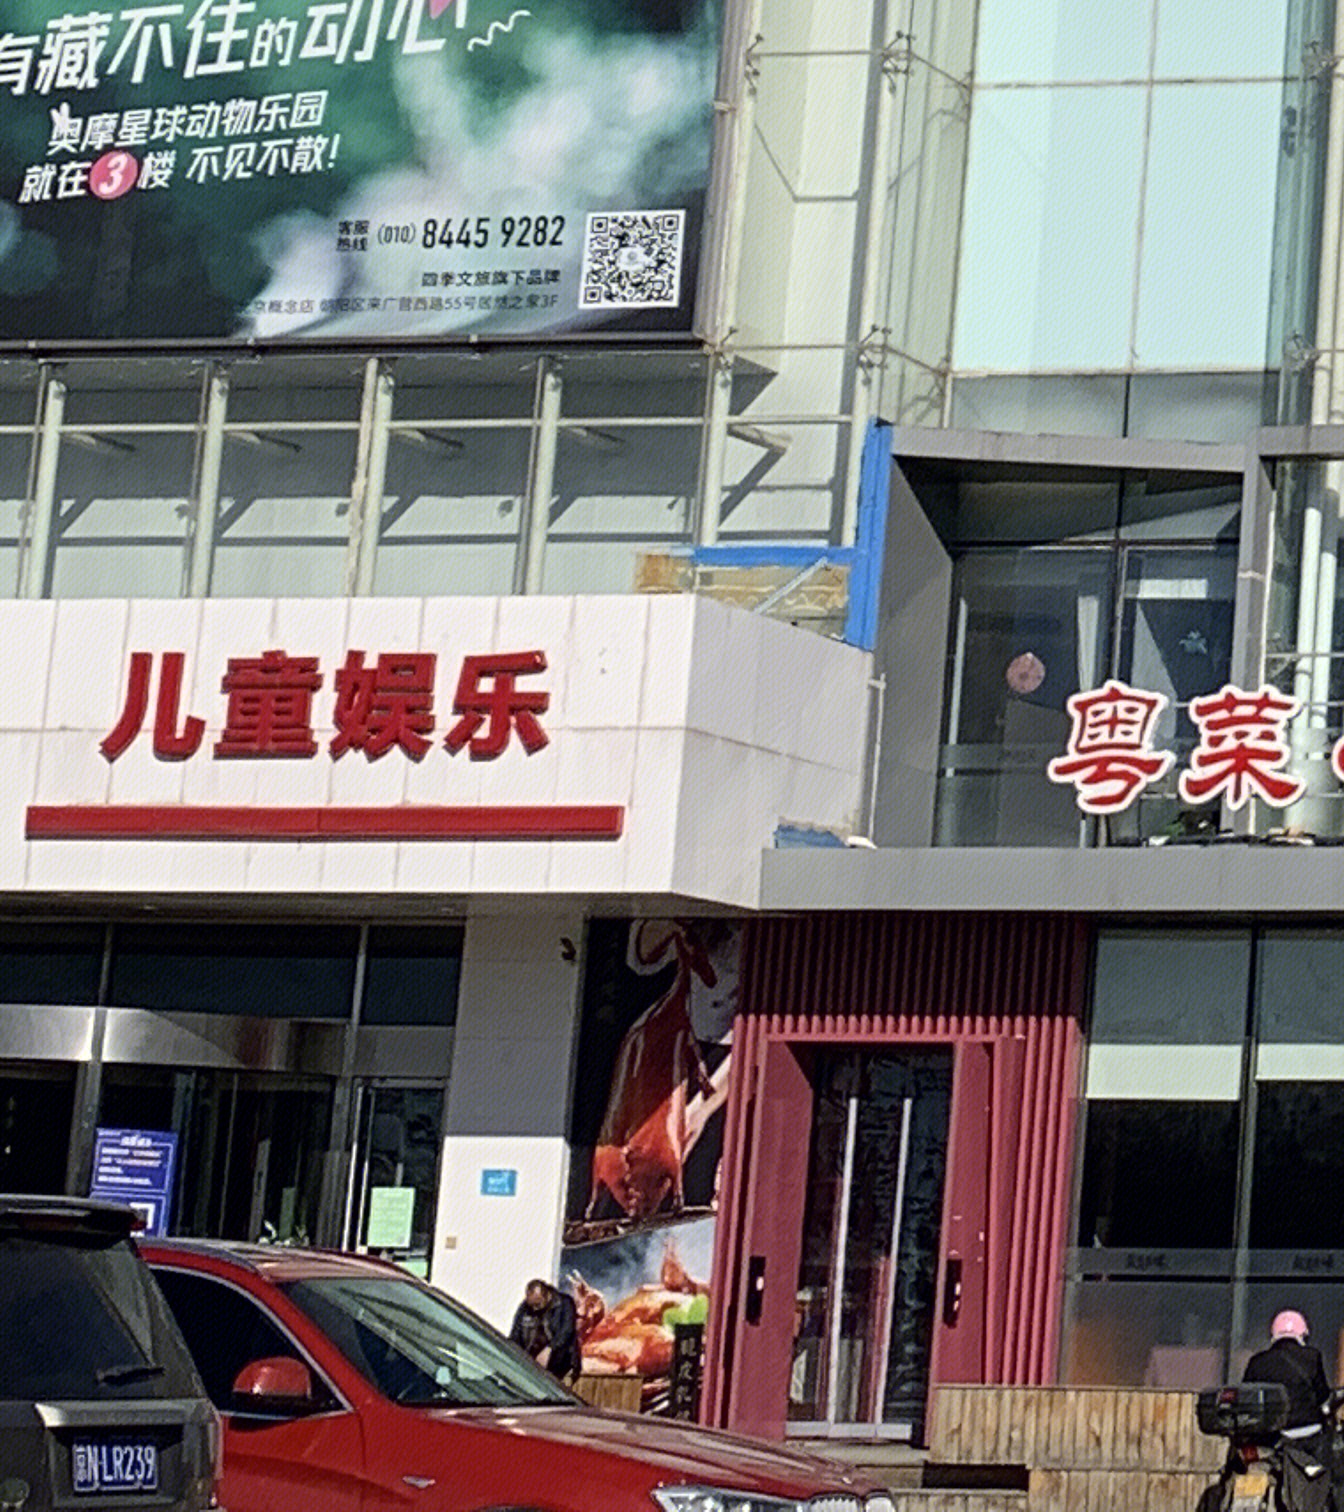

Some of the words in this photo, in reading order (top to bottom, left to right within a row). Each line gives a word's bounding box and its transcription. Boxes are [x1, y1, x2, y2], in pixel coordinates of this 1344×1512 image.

[47, 90, 329, 156] 奥摩星球动物乐园
[185, 134, 341, 184] 不见不散!
[378, 223, 417, 246] (010)
[422, 217, 491, 249] 8445
[501, 215, 565, 248] 9282
[98, 649, 550, 764] 儿童娱乐
